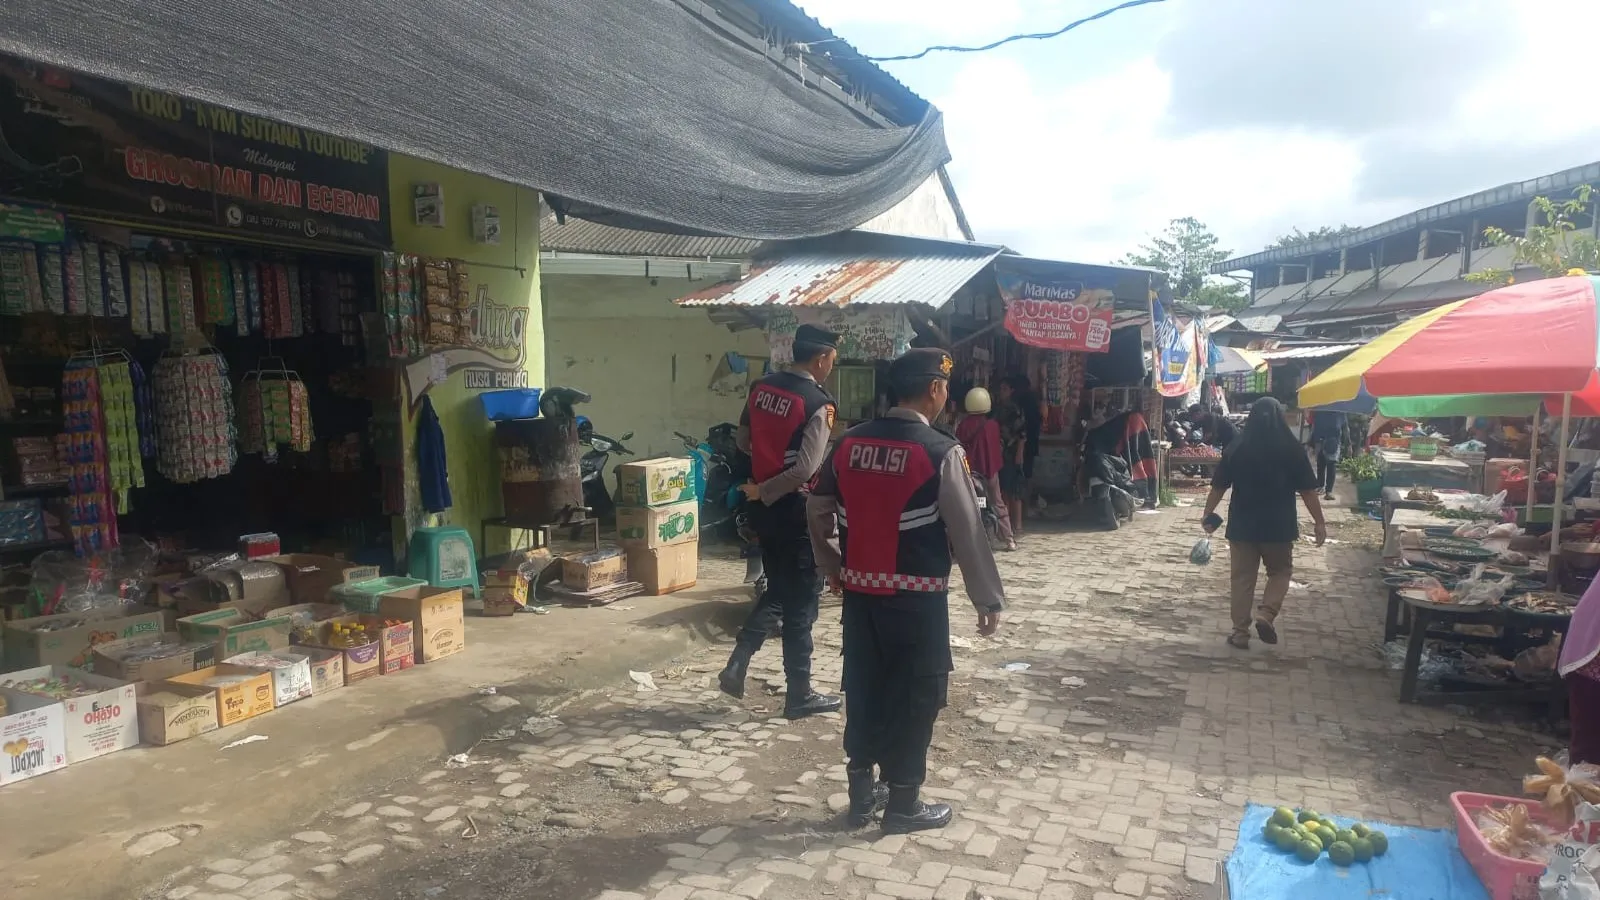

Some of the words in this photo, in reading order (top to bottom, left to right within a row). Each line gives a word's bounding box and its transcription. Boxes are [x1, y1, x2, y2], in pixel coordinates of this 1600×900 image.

[132, 88, 181, 121] TOKO
[242, 115, 301, 147] SUTANA
[242, 146, 297, 173] Melayani
[125, 147, 253, 199] GROSIRAN
[258, 173, 303, 207] DAN
[306, 182, 380, 221] ECERAN
[1014, 299, 1090, 324] JUMBO
[754, 390, 792, 419] POLISI
[848, 444, 909, 474] POLISI
[10, 748, 45, 775] JACKPOT
